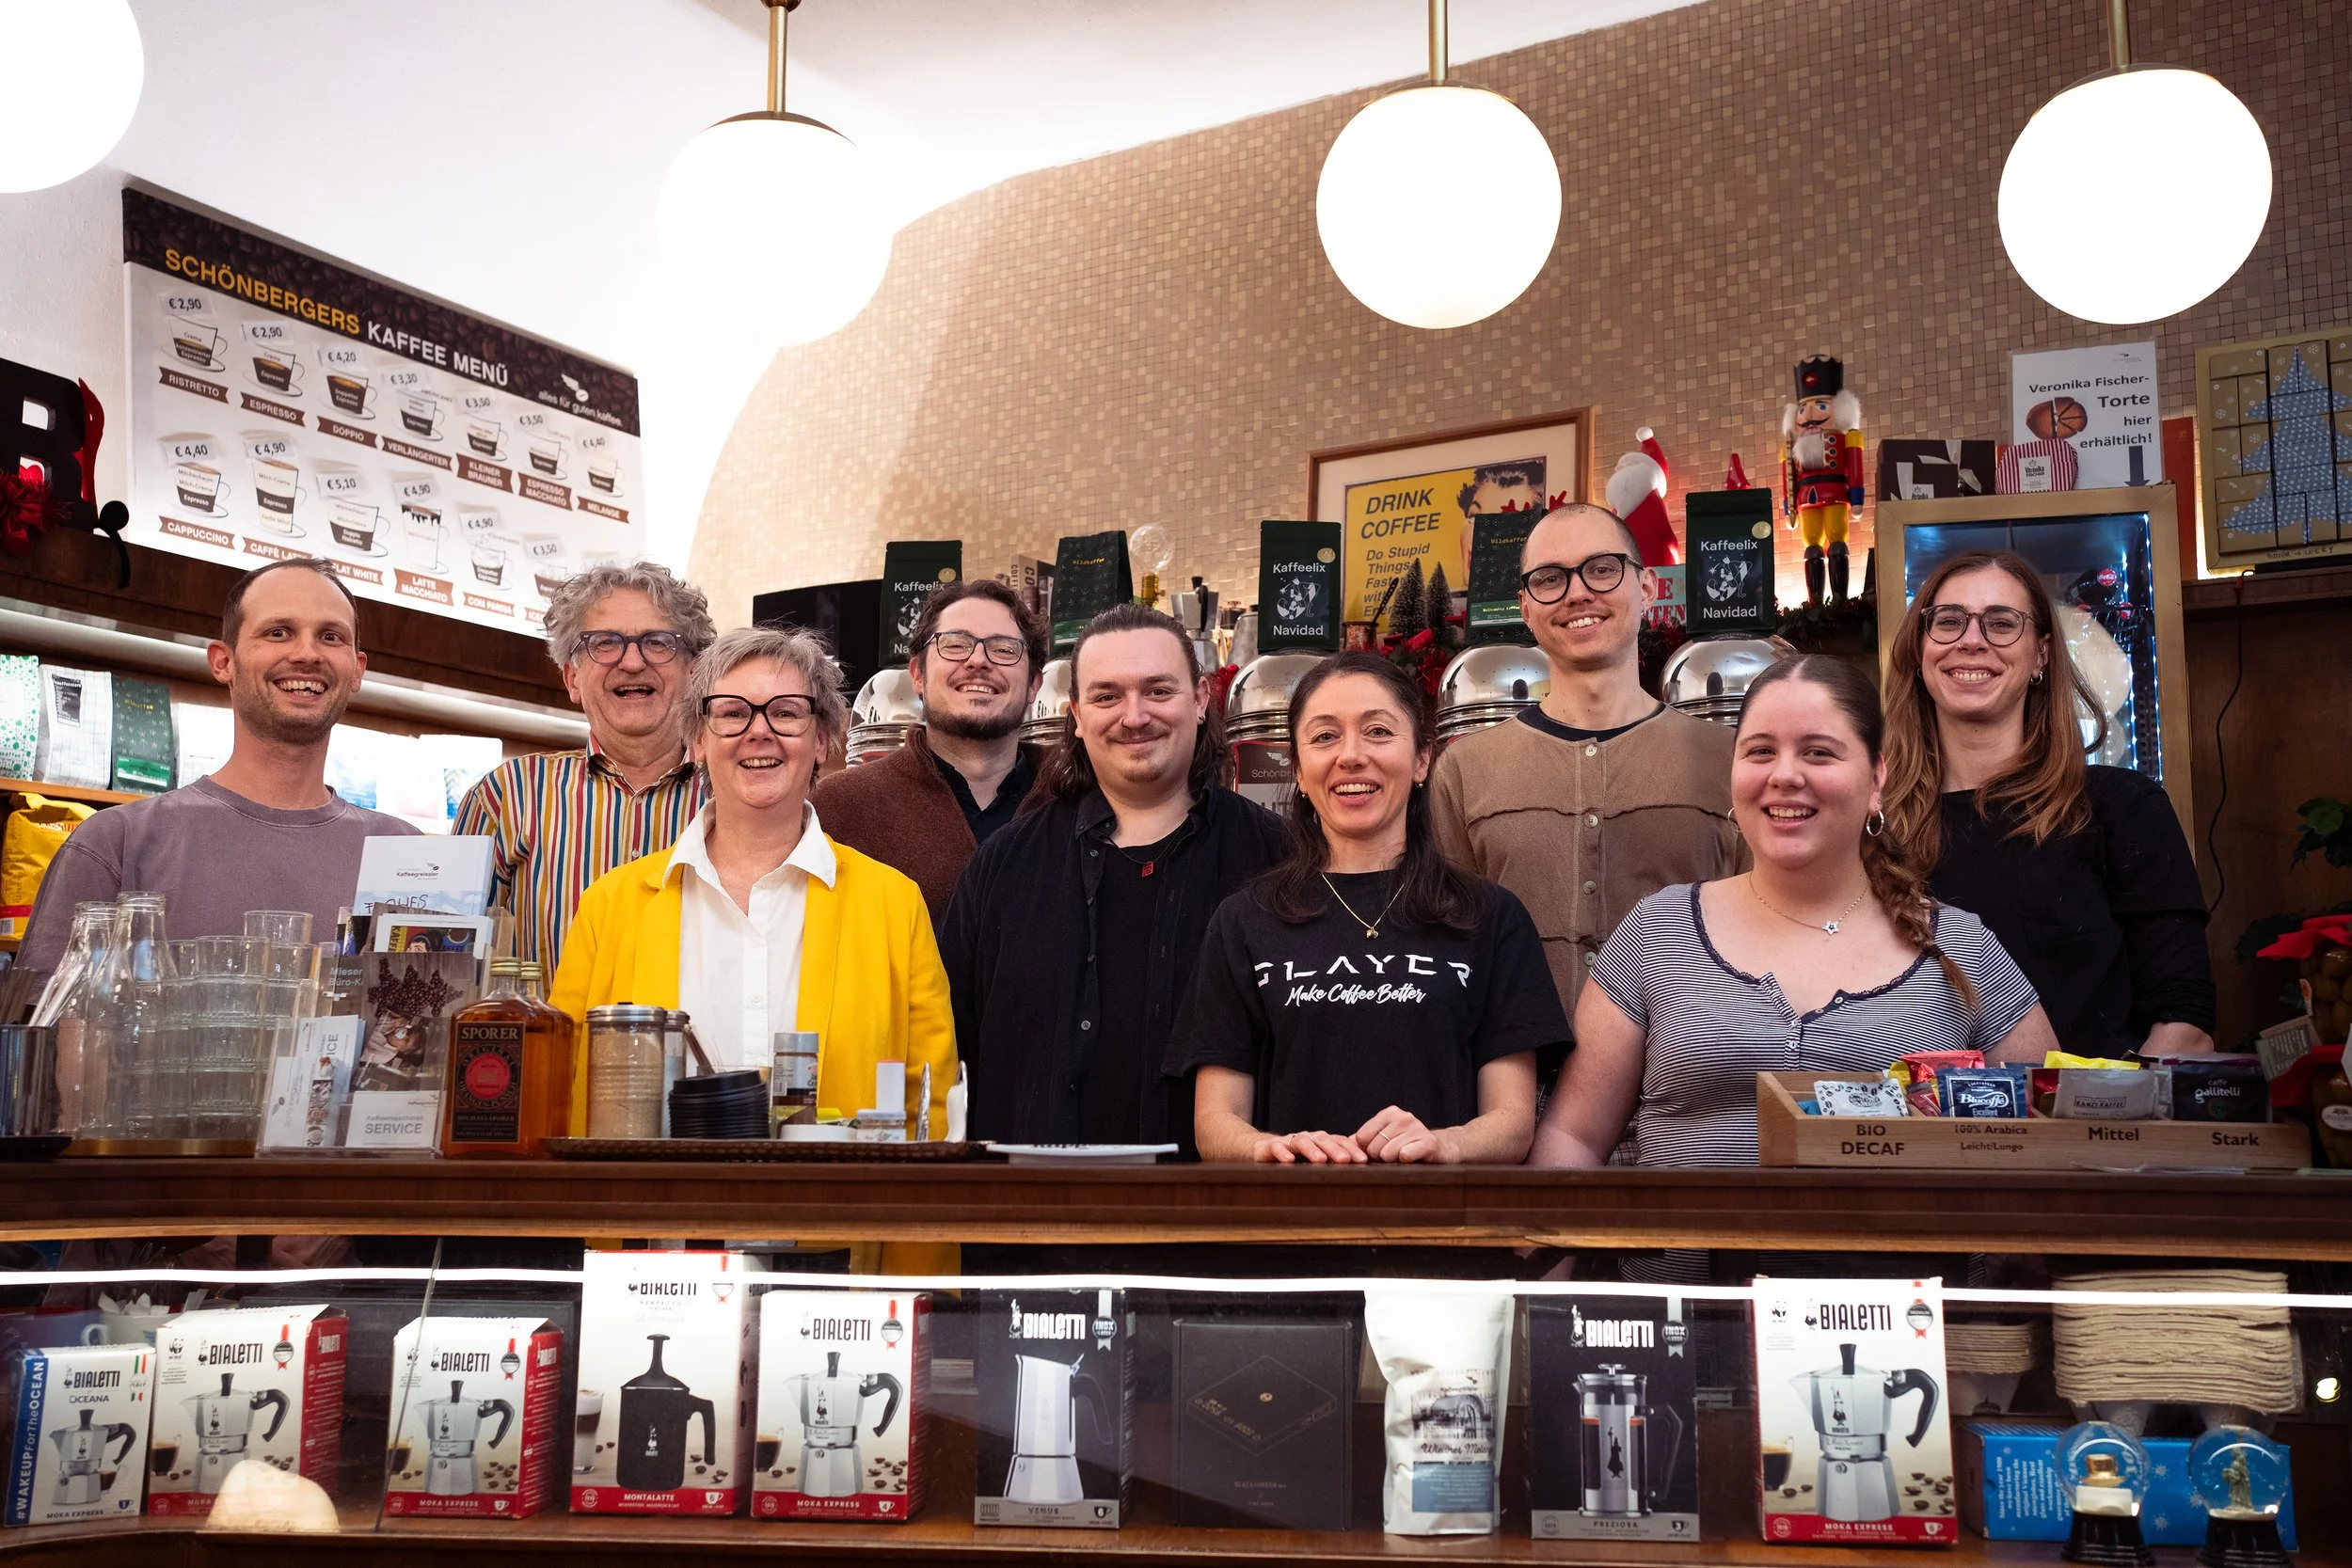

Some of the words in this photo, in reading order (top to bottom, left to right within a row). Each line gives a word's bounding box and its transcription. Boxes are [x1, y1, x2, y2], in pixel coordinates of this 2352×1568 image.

[178, 298, 202, 311] 2,90
[166, 248, 359, 335] SCHÖNBERGERS
[368, 321, 447, 366] KAFFEE
[453, 351, 508, 387] MENÜ
[262, 326, 282, 339] 2,90
[168, 374, 220, 397] RISTRETTO
[2029, 379, 2091, 393] Veronika
[2095, 374, 2150, 388] Fischer-
[2097, 394, 2150, 408] Torte
[249, 399, 297, 421] ESPRESSO
[2123, 415, 2152, 426] hier
[332, 424, 364, 441] DOPPIO
[2080, 433, 2152, 449] erhältlich!
[184, 445, 208, 457] 4,40
[262, 442, 286, 455] 4,90
[183, 494, 209, 506] Espresso
[263, 497, 287, 509] Espresso
[1366, 488, 1434, 515] DRINK
[1361, 513, 1440, 539] COFFEE
[167, 522, 230, 546] CAPPUCCINO
[1700, 539, 1758, 551] Kaffeelix
[1366, 549, 1383, 561] Do
[1388, 543, 1430, 559] Stupid
[1273, 562, 1326, 573] Kaffeelix
[1368, 562, 1410, 575] Things
[353, 568, 378, 582] WHITE
[412, 576, 437, 590] LATTE
[402, 583, 448, 602] MACCHIATO
[1703, 606, 1757, 619] Navidad
[1273, 625, 1324, 636] Navidad
[1285, 984, 1327, 1006] Make
[1327, 983, 1377, 1005] Coffee
[1376, 982, 1426, 1004] Better
[461, 1027, 518, 1039] SPORER
[2195, 1087, 2241, 1103] gallitelli
[364, 1123, 424, 1134] SERVICE
[1856, 1125, 1886, 1136] BIO
[1954, 1125, 1981, 1134] 100%
[1984, 1125, 2028, 1134] Arabica
[2089, 1127, 2139, 1141] Mittel
[2212, 1132, 2260, 1147] Stark
[1841, 1142, 1905, 1156] DECAF
[1961, 1142, 2024, 1152] Leicht/Lungo
[1095, 1321, 1115, 1331] INOX
[1664, 1325, 1686, 1337] INOX
[70, 1395, 110, 1404] OCEANA
[72, 1510, 104, 1518] EXPRESS
[1594, 1520, 1639, 1528] PREZIOSA
